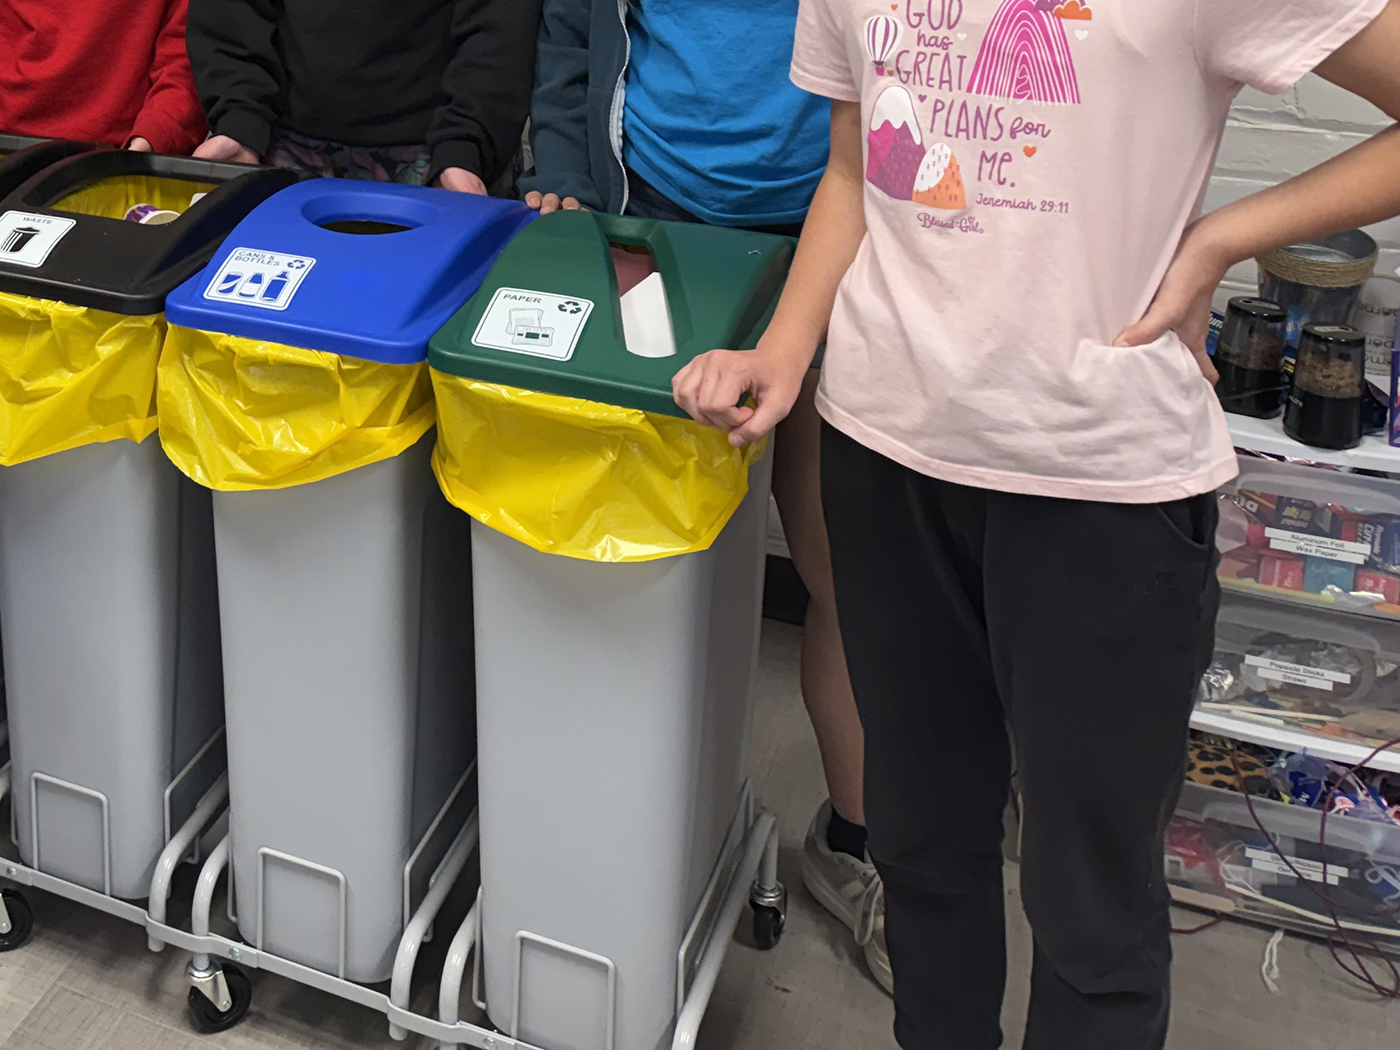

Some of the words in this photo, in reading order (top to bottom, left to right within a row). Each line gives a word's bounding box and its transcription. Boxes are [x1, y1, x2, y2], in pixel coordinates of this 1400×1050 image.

[916, 29, 953, 50] has
[895, 49, 967, 92] GREAT
[930, 98, 1005, 142] PLANS
[1009, 116, 1052, 140] for
[976, 192, 1037, 211] Jeremiah
[1039, 201, 1070, 214] 29:11
[22, 216, 54, 225] WASTE
[916, 211, 955, 229] Blessed
[234, 255, 281, 267] BOTTLES
[238, 251, 266, 259] CANS
[503, 293, 542, 304] PAPER
[1290, 533, 1329, 545] Aluminum
[1296, 545, 1312, 553] Wax
[1315, 549, 1338, 558] Paper
[1269, 661, 1301, 673] Popsicle
[1302, 667, 1325, 678] Sticks
